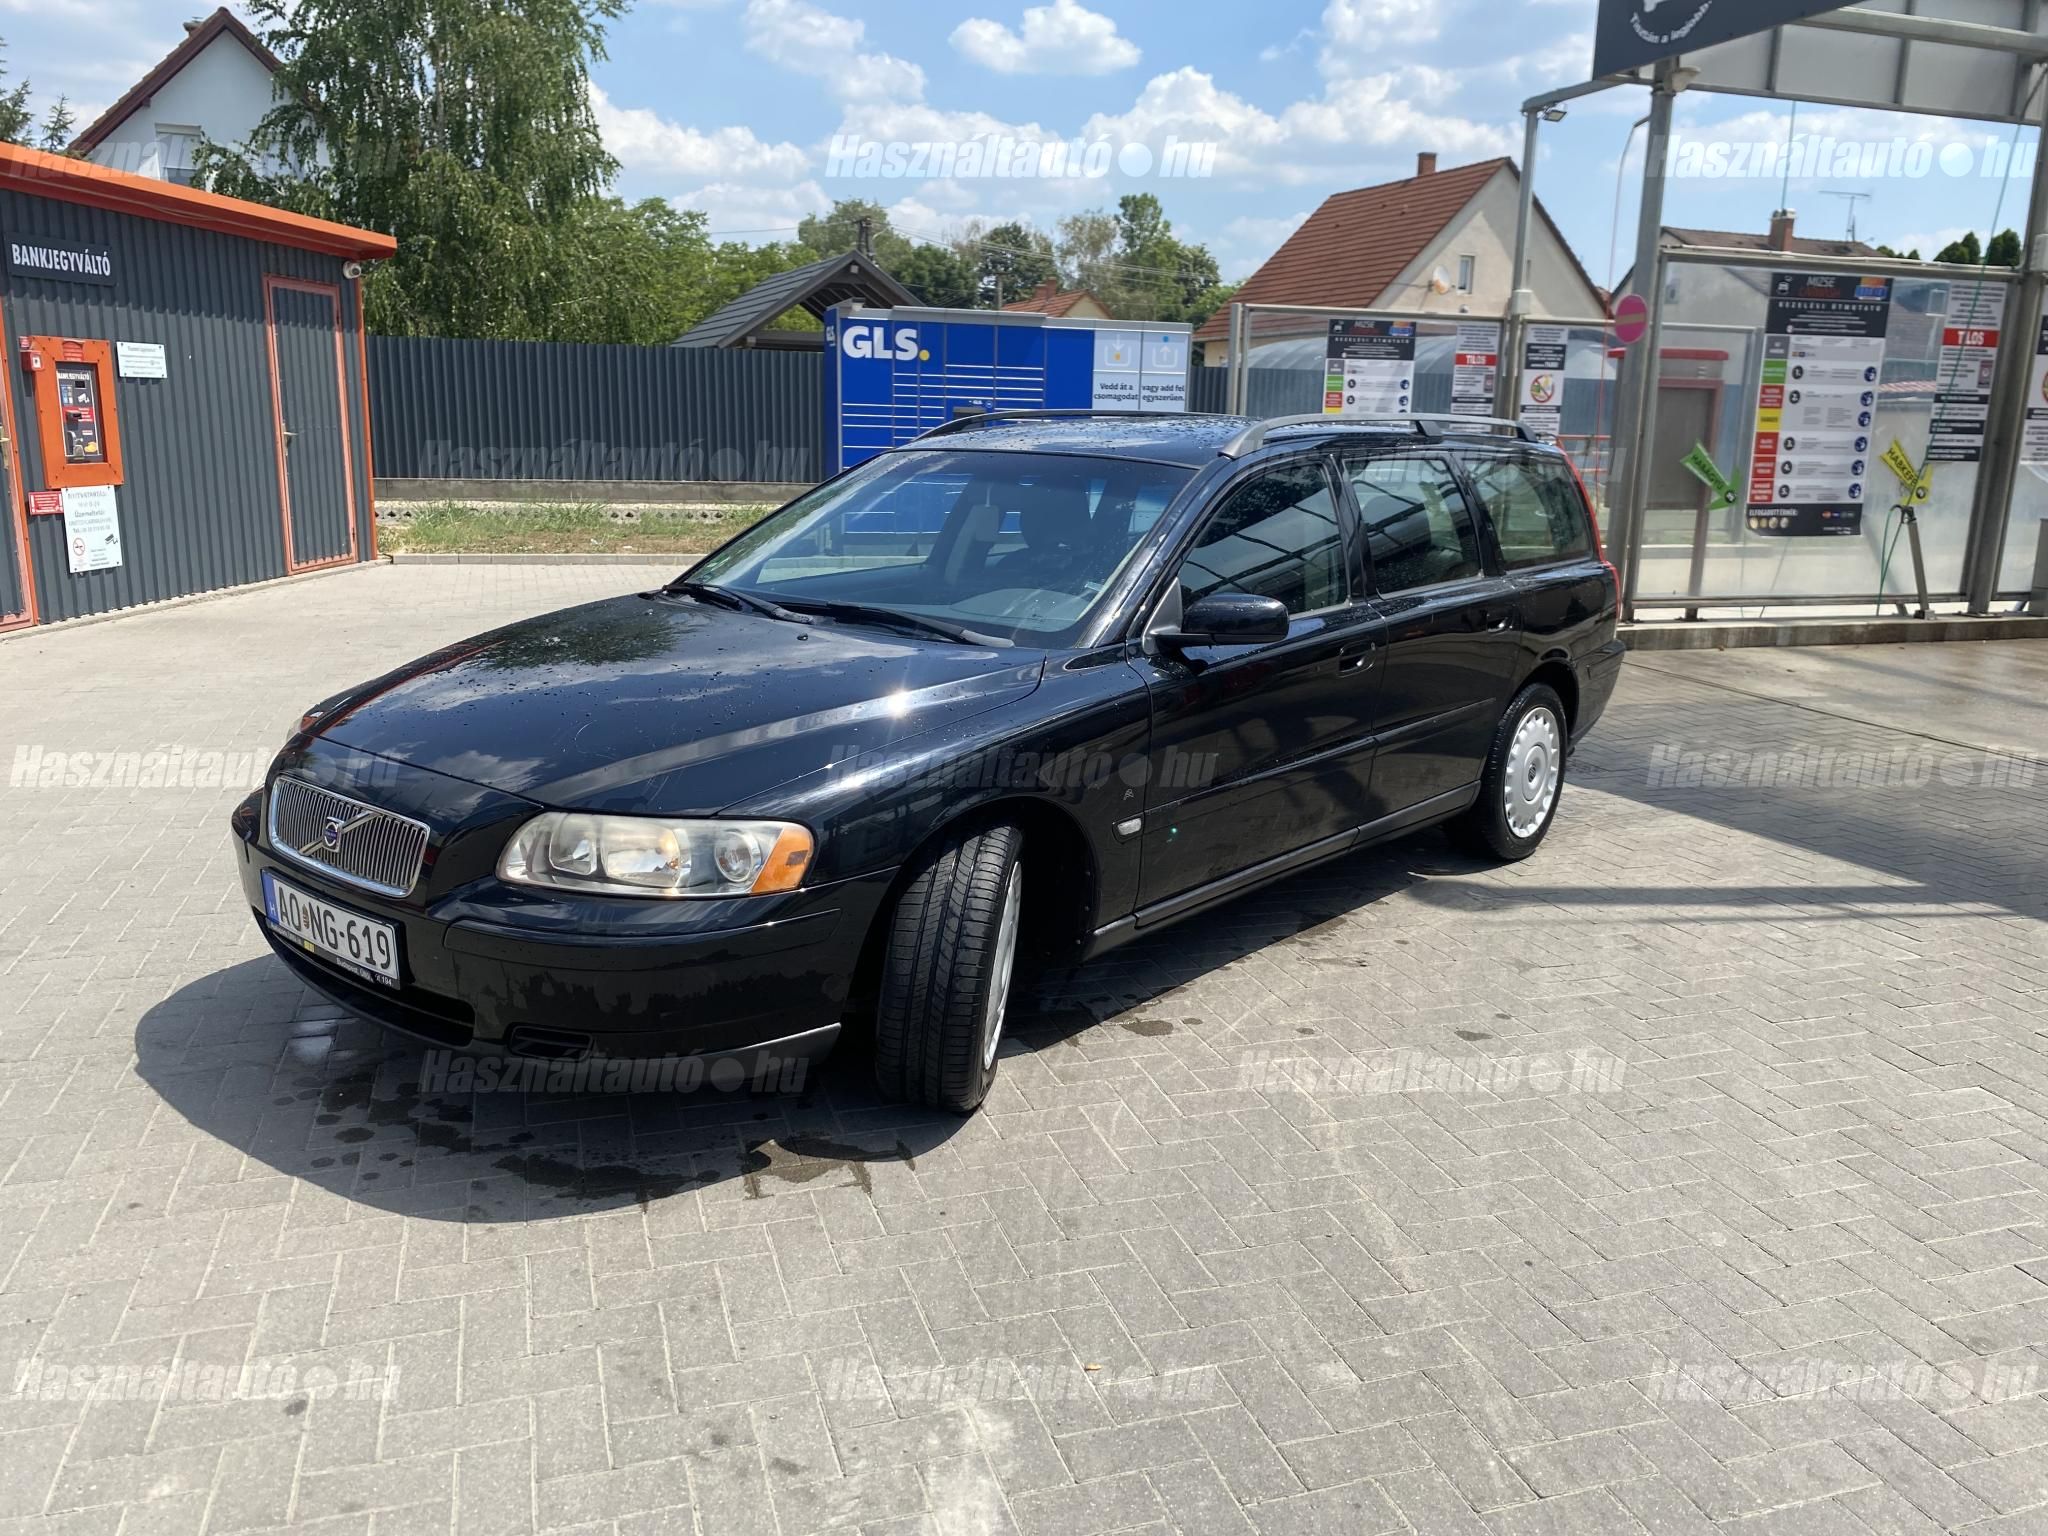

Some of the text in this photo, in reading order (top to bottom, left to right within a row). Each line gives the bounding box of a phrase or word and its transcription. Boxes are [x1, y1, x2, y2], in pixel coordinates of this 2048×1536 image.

[11, 243, 111, 276] BANKJEGYVÁLTÓ
[1957, 330, 1985, 345] TLOS
[1142, 385, 1159, 393] vagy
[1094, 393, 1138, 401] csomagodat
